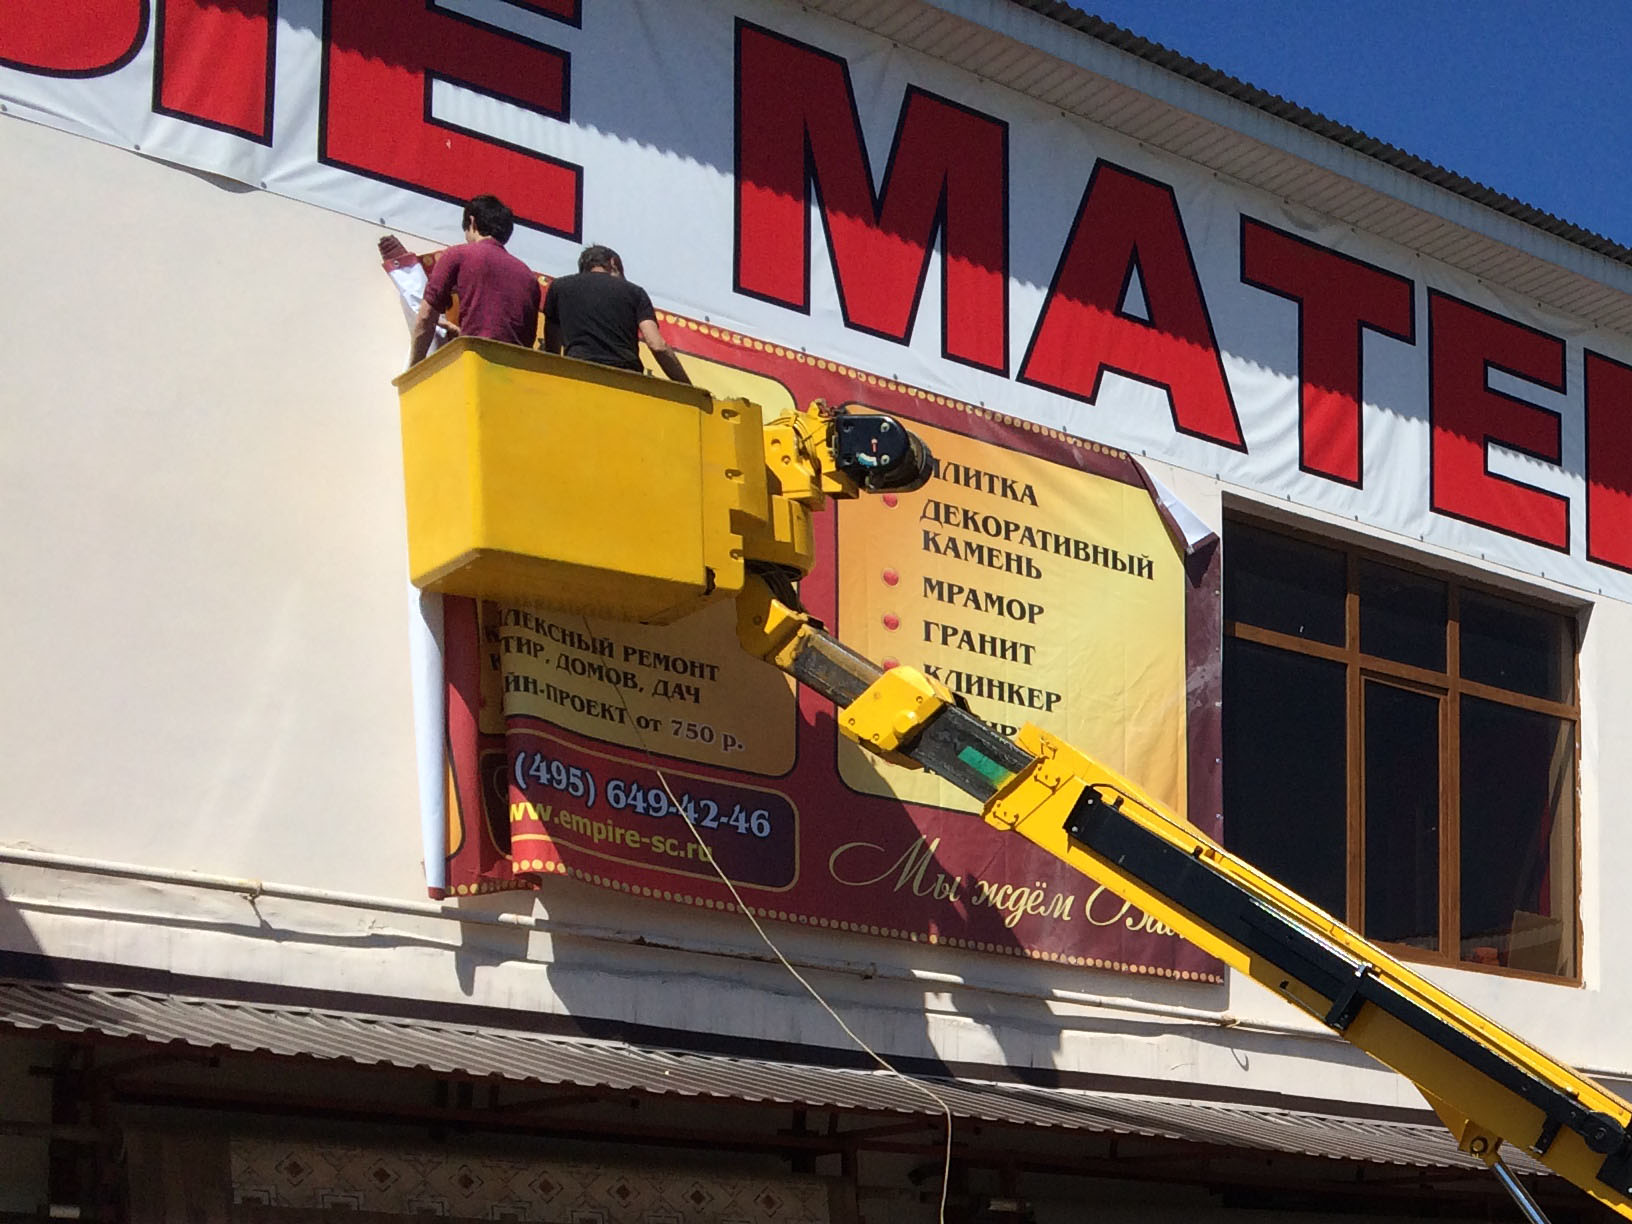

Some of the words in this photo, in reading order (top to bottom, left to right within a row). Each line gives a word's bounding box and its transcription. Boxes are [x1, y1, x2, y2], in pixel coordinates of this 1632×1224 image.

[919, 498, 1155, 581] ДЕКОРАТИВНЫЙ
[921, 529, 1043, 580] КАМЕНЬ
[922, 576, 1045, 624] МРАМОР
[502, 608, 615, 659] ЛЕКСНЫЙ
[622, 647, 720, 682] РЕМОНТ
[922, 619, 1036, 665] ГРАНИТ
[555, 652, 645, 693] ДОМОВ,
[651, 678, 701, 704] ДАЧ
[923, 663, 1062, 713] КЛИНКЕР
[636, 714, 662, 732] от
[671, 719, 715, 745] 750
[721, 732, 745, 751] р.
[514, 751, 597, 808] (495)
[606, 779, 772, 838] 649-42-46
[828, 834, 962, 903] Мы
[972, 881, 1075, 929] ждём
[1085, 884, 1187, 941] Ва
